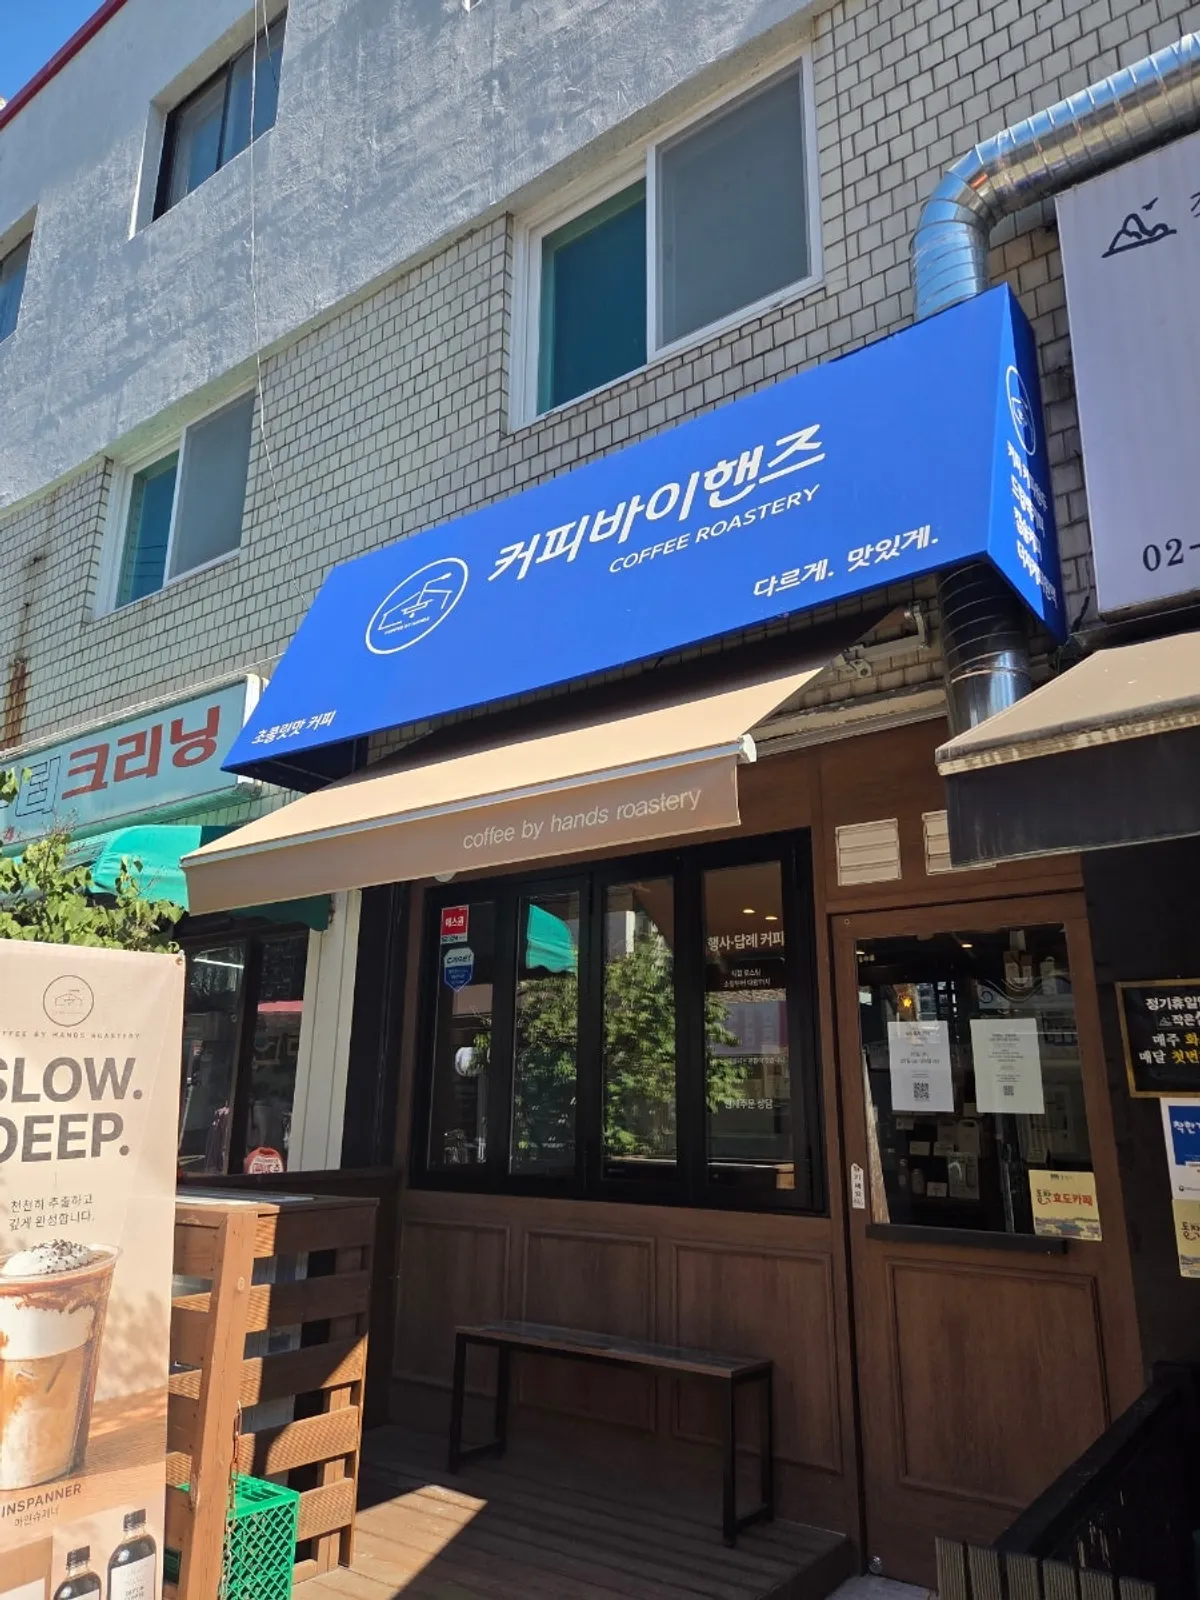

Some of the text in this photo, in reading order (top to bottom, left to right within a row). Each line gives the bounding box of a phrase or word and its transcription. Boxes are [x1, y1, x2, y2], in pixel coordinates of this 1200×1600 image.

[487, 424, 826, 584] 커피바이핸즈
[609, 485, 821, 574] COFFEE ROASTERY
[753, 524, 939, 599] 다르게. 맛있게.
[305, 710, 337, 731] 커피
[463, 789, 702, 850] coffee by hands roastery
[760, 930, 785, 948] 커피
[1152, 1033, 1181, 1048] 매주
[1139, 1049, 1166, 1065] 매달
[11, 1194, 93, 1213] 천천히 추출하고
[9, 1210, 95, 1232] 깊게 완성합니다.
